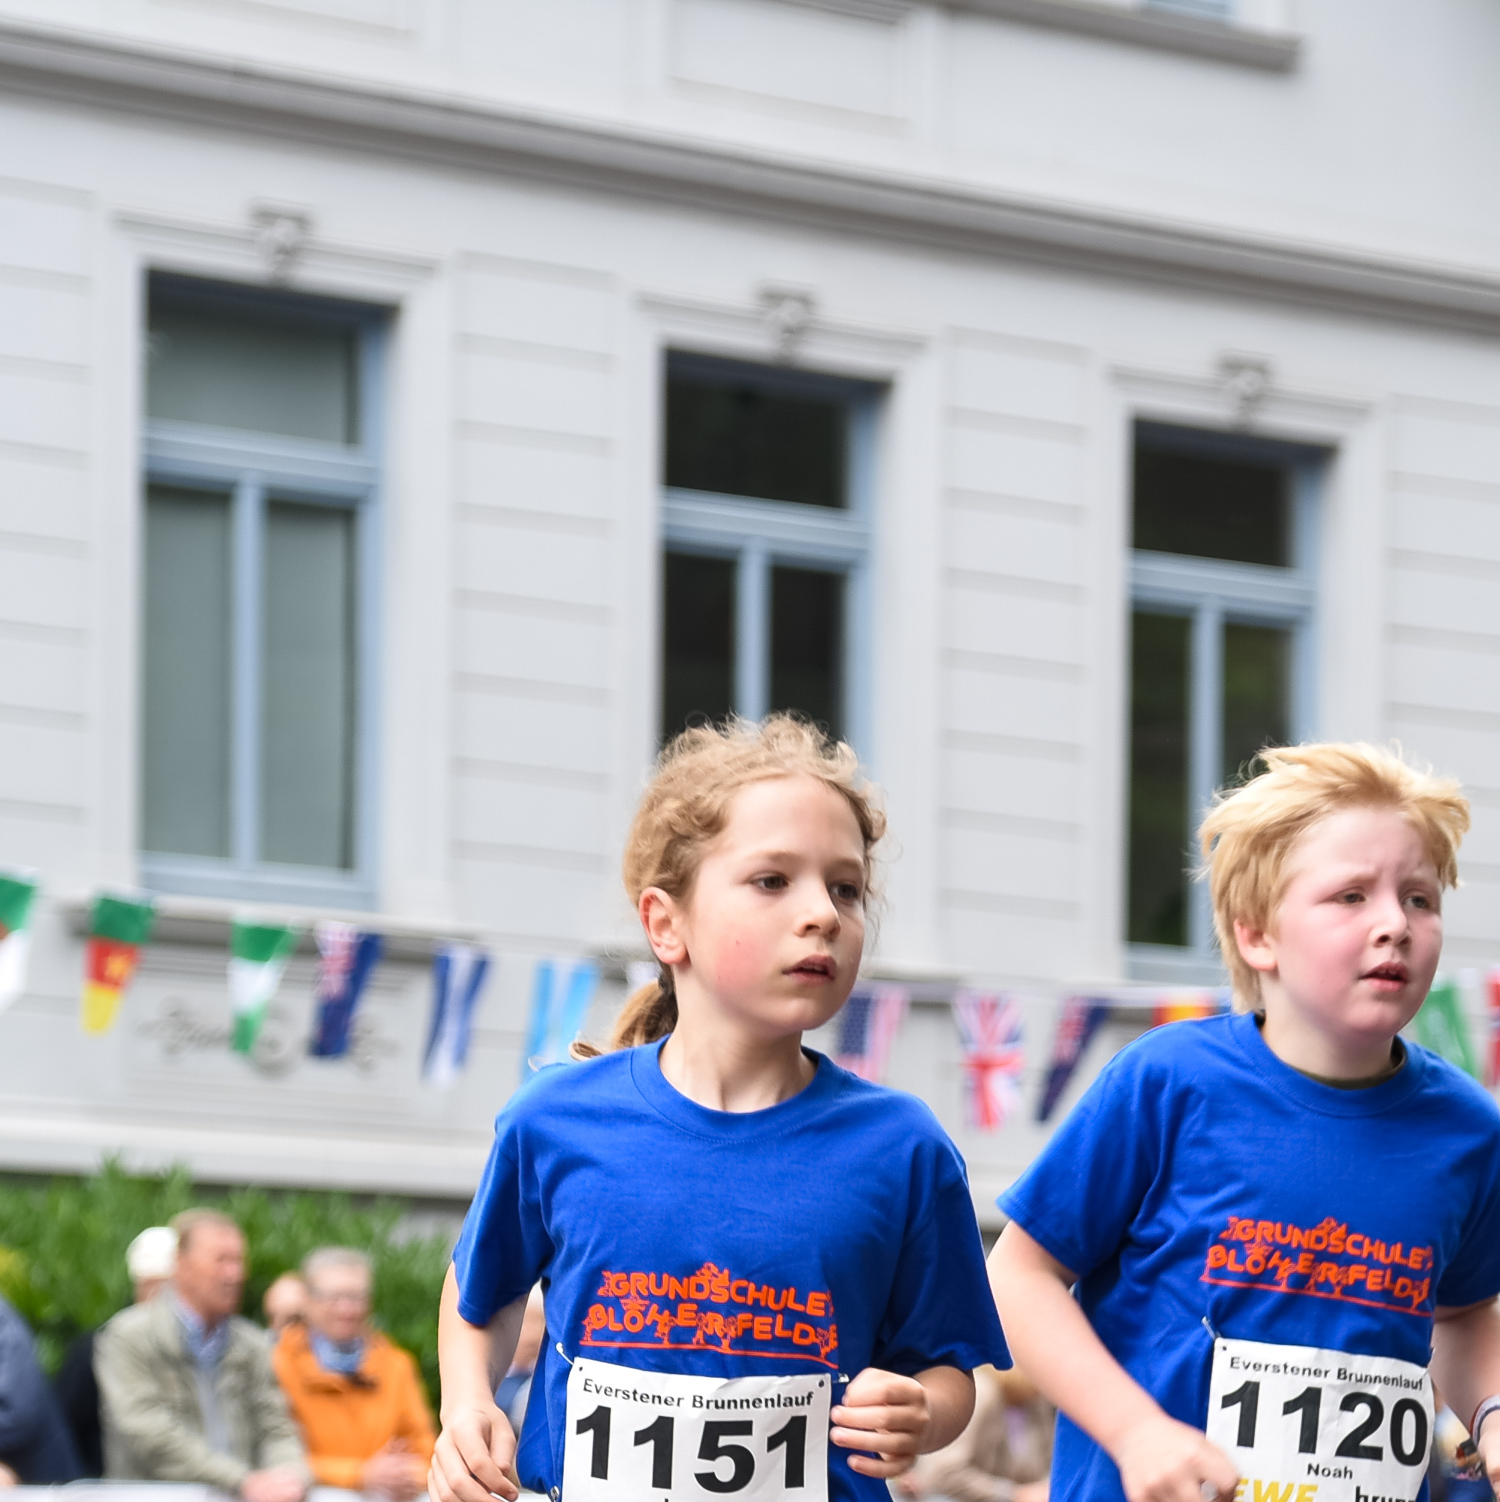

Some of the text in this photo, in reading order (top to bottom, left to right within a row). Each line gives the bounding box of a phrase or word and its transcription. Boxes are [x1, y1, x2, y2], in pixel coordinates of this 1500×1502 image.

[1235, 1220, 1424, 1270] GRUNDSCHULE
[609, 1271, 827, 1317] GRUNDSCHULE
[583, 1378, 814, 1411] Everstener Brunnenlauf
[1230, 1356, 1424, 1392] Everstener Brunnenlauf
[1220, 1380, 1428, 1467] 1120
[576, 1404, 808, 1493] 1151
[1306, 1463, 1354, 1480] Noah
